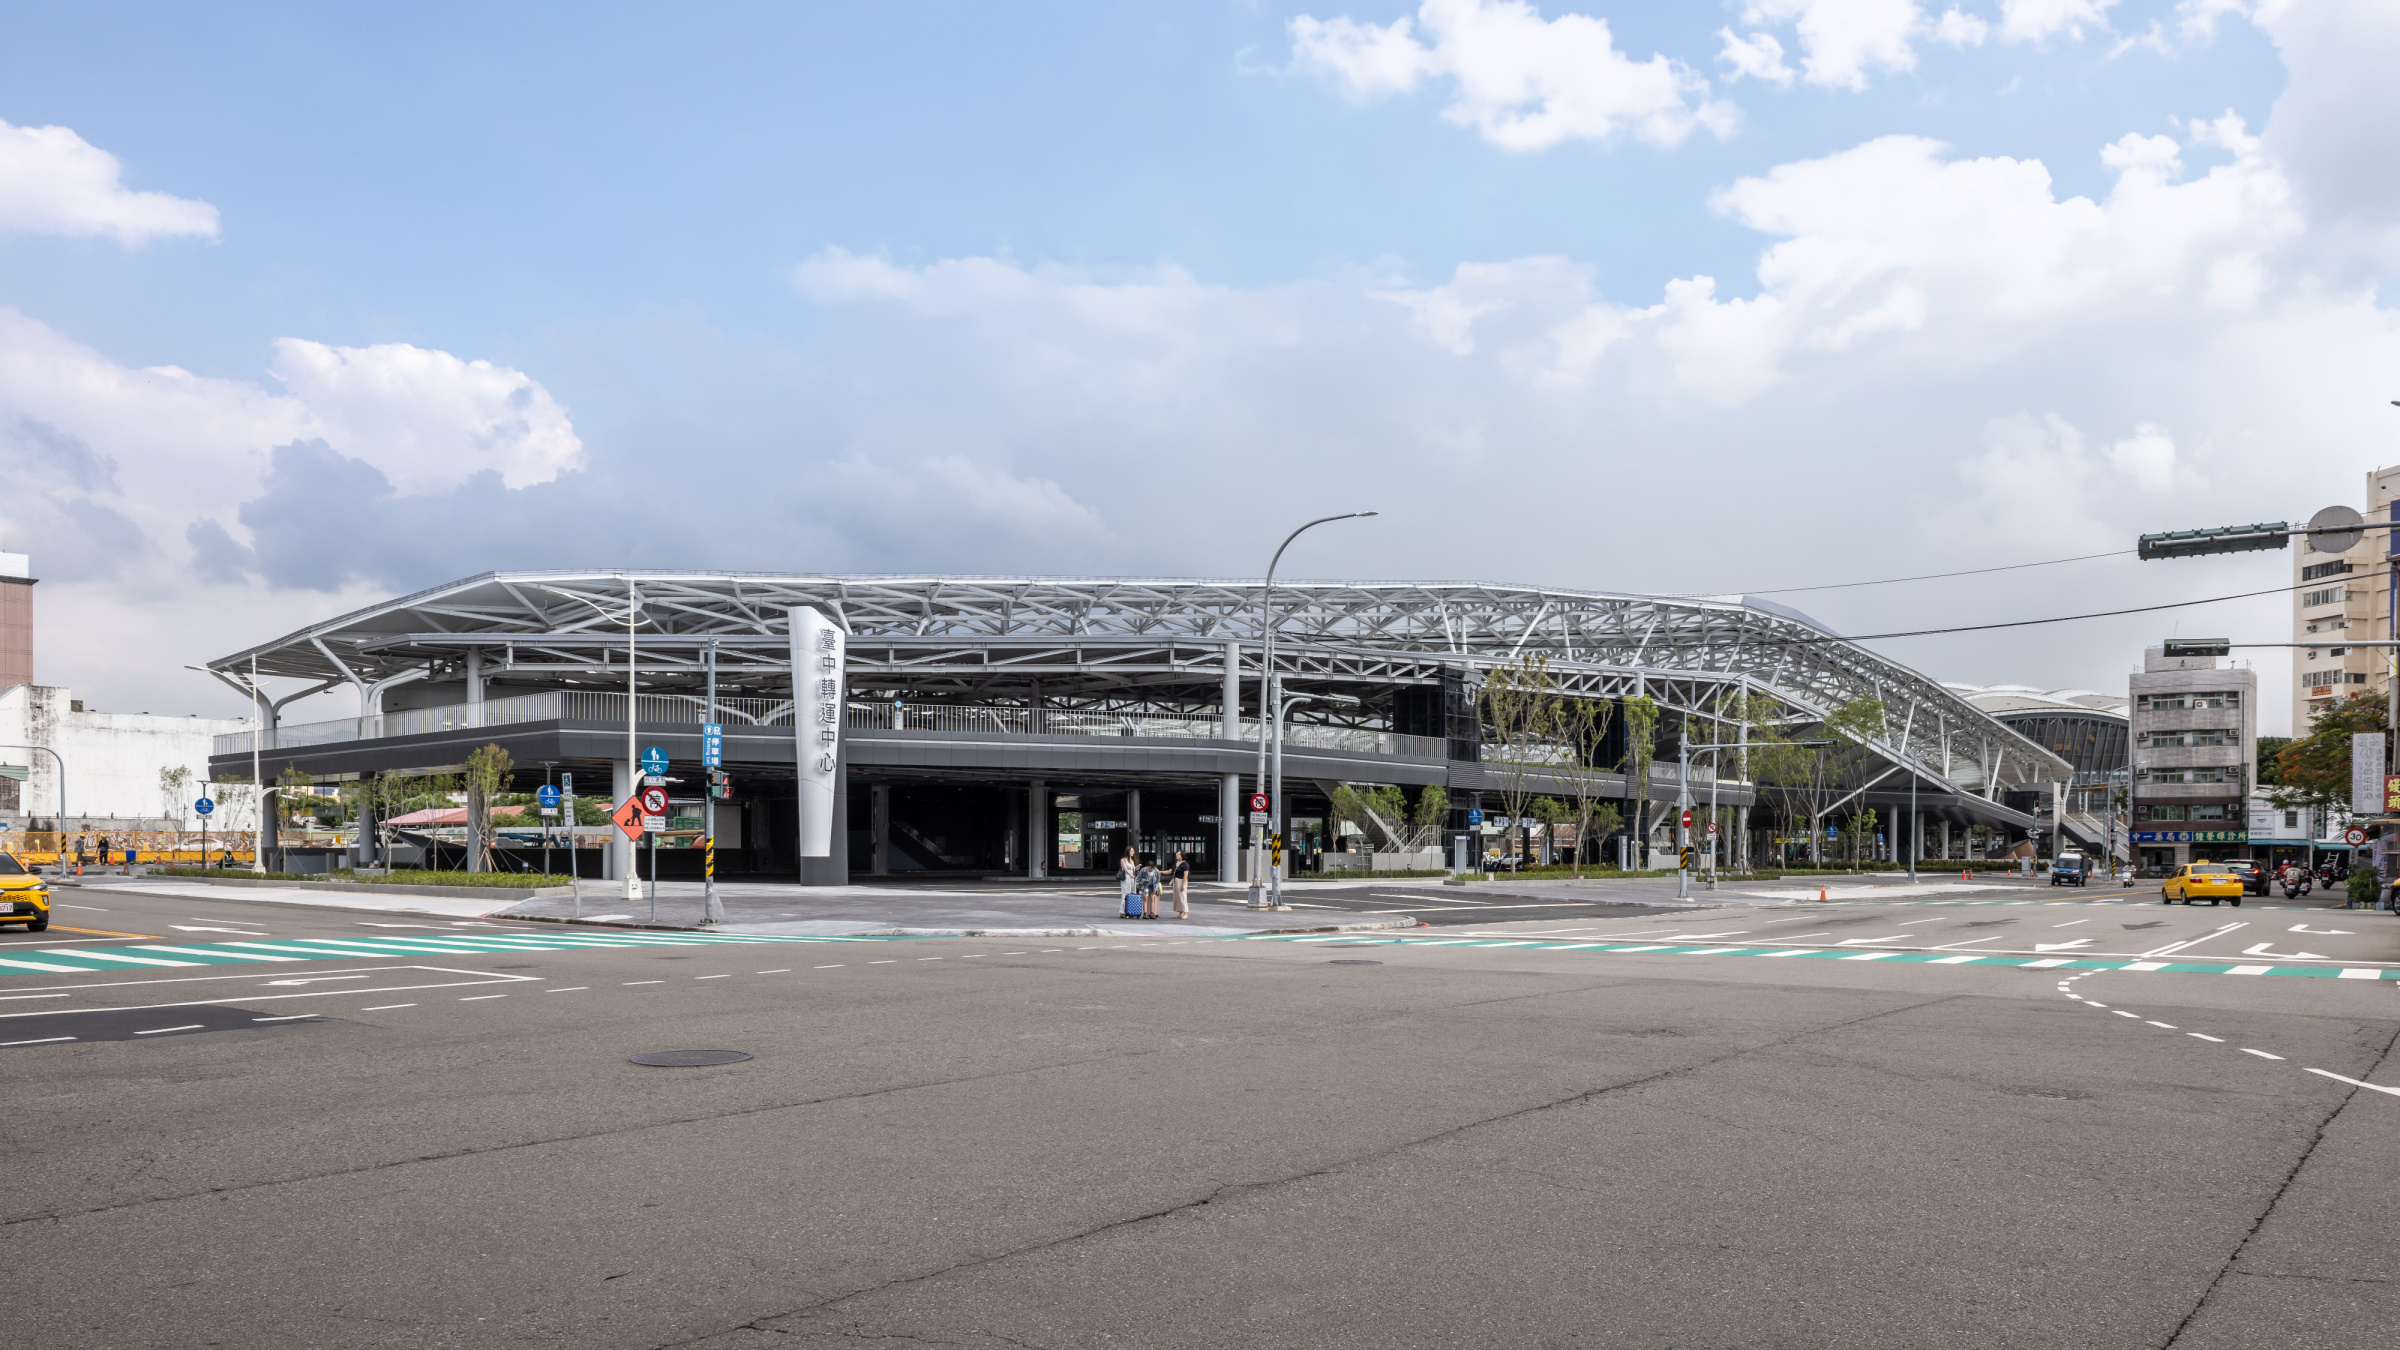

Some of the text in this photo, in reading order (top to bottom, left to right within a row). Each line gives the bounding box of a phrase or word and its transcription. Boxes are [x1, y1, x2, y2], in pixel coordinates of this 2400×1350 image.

[820, 628, 836, 773] 臺中轉運中心
[711, 737, 720, 765] 停車場
[2132, 832, 2175, 842] 中一藥局
[2349, 833, 2362, 841] 30
